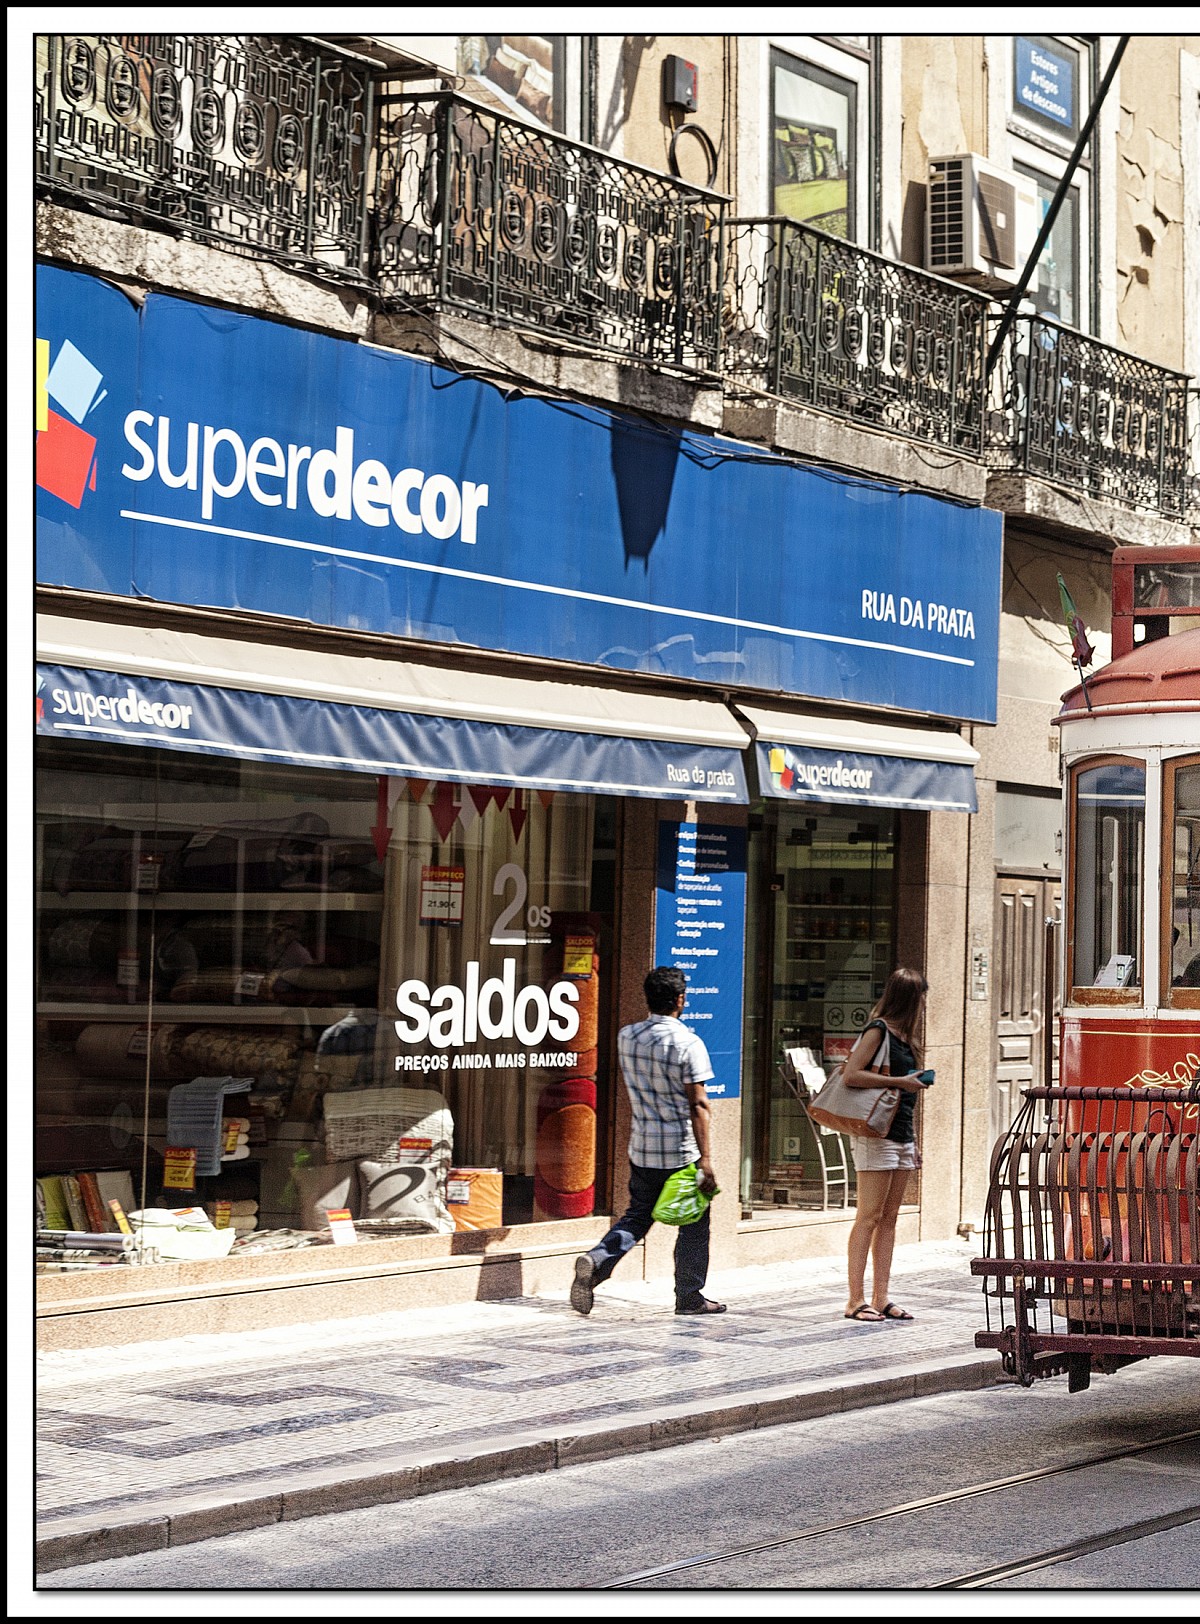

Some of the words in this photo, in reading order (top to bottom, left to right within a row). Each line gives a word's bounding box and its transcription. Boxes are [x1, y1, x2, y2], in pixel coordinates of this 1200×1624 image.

[1031, 50, 1058, 75] Estores
[1030, 70, 1059, 95] Artigos
[1022, 85, 1033, 101] de
[1033, 91, 1067, 118] descanso
[121, 410, 489, 544] superdecor
[862, 589, 896, 623] RUA
[900, 596, 924, 628] DA
[927, 602, 975, 639] PRATA
[52, 688, 193, 730] superdecor
[666, 763, 690, 783] Rua
[691, 766, 706, 784] da
[706, 768, 736, 788] prata
[797, 760, 873, 790] superdecor
[394, 957, 580, 1049] saldos
[395, 1054, 449, 1074] PREÇOS
[451, 1054, 492, 1070] AINDA
[495, 1053, 527, 1068] MAIS
[529, 1052, 577, 1067] BAIXOS!
